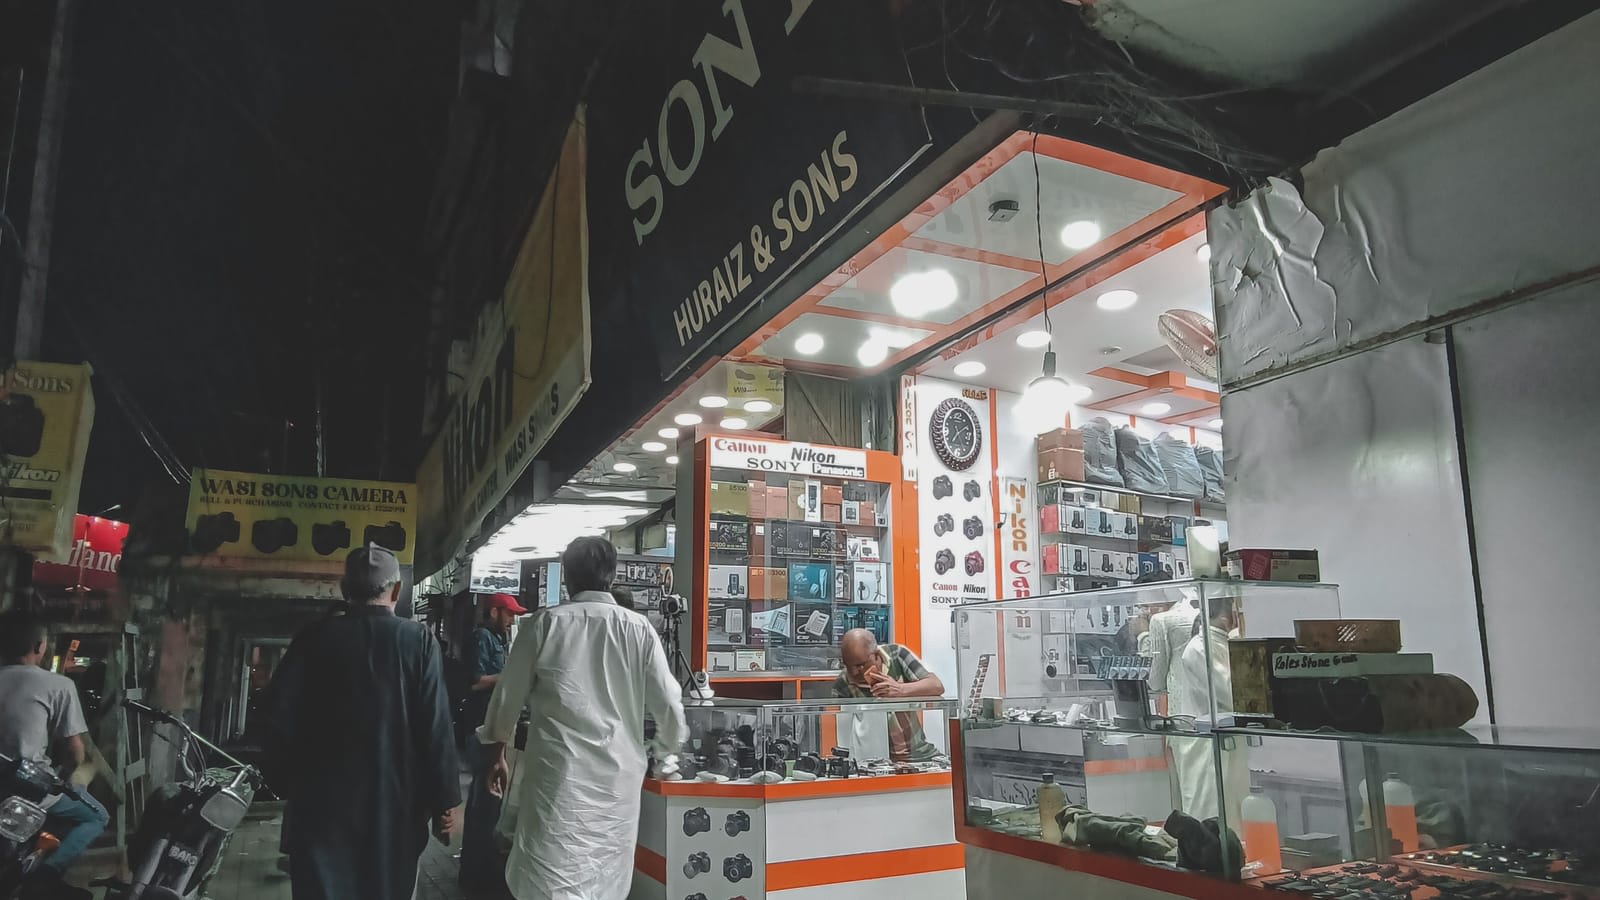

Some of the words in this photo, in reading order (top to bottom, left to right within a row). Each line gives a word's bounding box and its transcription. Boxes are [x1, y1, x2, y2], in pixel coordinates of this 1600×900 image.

[673, 242, 752, 346] HURAIZ
[750, 224, 775, 273] &
[772, 130, 858, 251] SONS
[13, 374, 72, 393] Sons
[505, 427, 527, 476] WASI
[529, 382, 559, 444] SS
[714, 439, 767, 454] Canon
[791, 447, 835, 464] Nikon
[8, 463, 61, 482] ikon
[747, 458, 801, 472] SONY
[813, 463, 864, 477] Panasonic
[200, 478, 256, 497] WASI
[262, 482, 319, 500] SONS
[323, 486, 408, 505] CAMERA
[1009, 483, 1027, 552] Nikon
[932, 582, 958, 591] Canon
[963, 584, 986, 593] Nikon
[931, 596, 958, 604] SONY
[1275, 656, 1300, 671] Rolex
[1301, 655, 1330, 669] Stone
